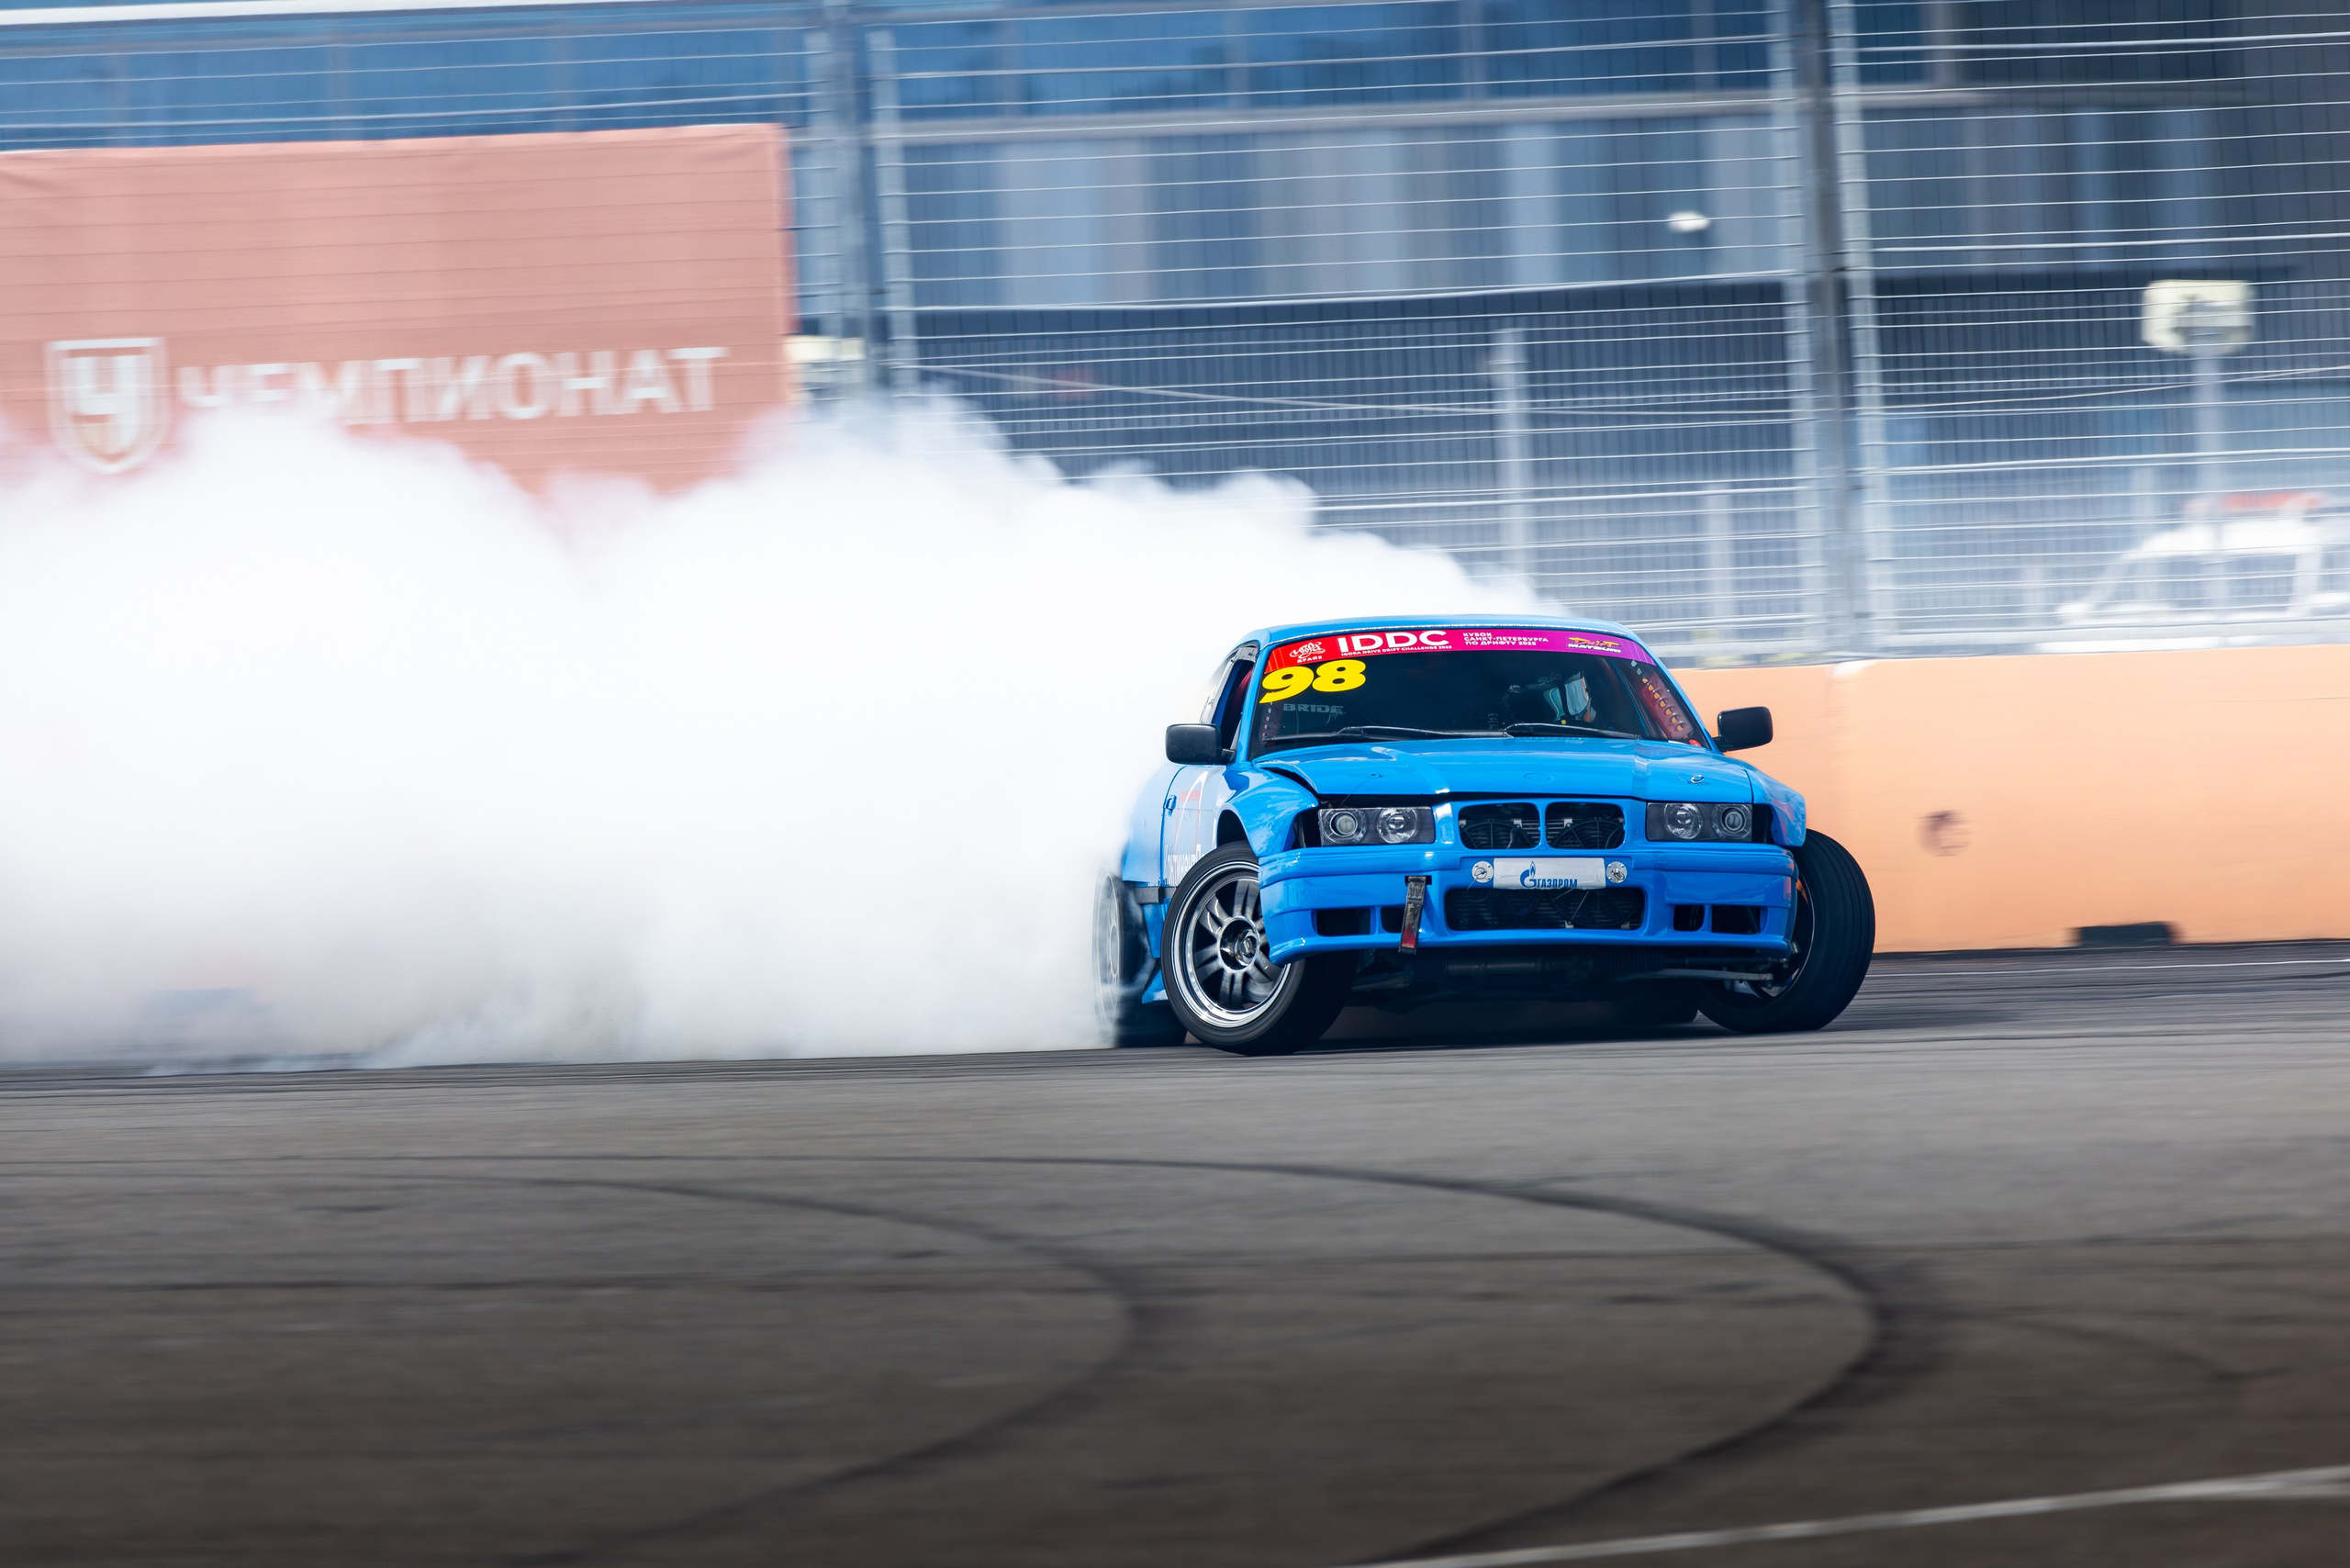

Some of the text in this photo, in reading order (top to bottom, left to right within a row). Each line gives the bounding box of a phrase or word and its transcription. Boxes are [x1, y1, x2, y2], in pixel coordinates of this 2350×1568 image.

[176, 345, 730, 426] ЧЕМПИОНАТ
[1337, 630, 1449, 653] IDDC
[1259, 659, 1367, 704] 98
[1282, 702, 1344, 714] BRIDE
[1536, 879, 1578, 889] ГАЗПРОМ
